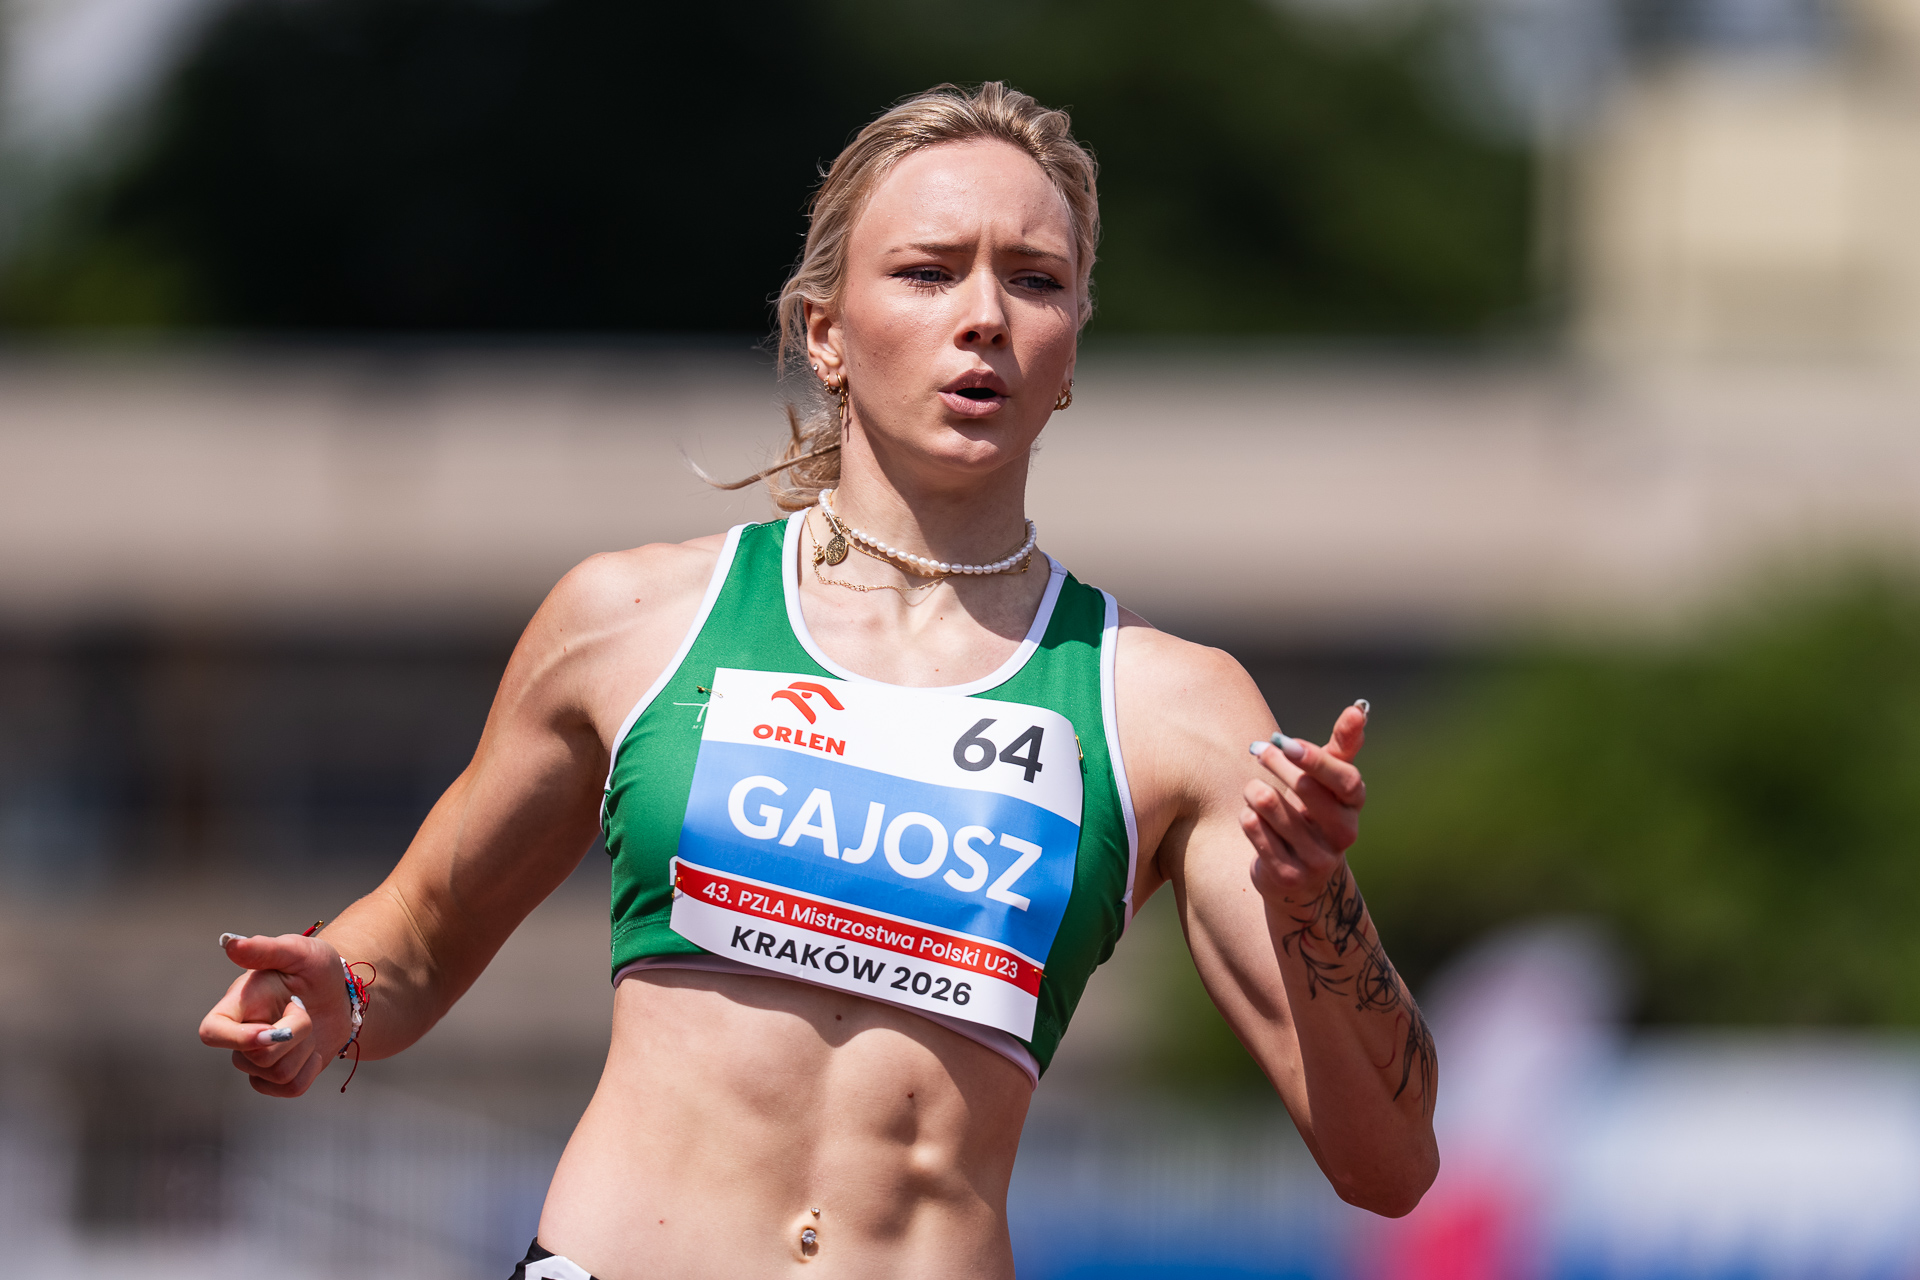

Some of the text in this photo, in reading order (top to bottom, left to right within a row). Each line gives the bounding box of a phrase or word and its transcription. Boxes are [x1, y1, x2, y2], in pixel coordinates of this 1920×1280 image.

[753, 724, 846, 756] ORLEN
[953, 718, 1045, 784] 64
[728, 775, 1043, 912] GAJOSZ
[702, 881, 1019, 979] 43. PZLA Mistrzostwa Polski U23
[731, 926, 972, 1006] KRAKÓW 2026
